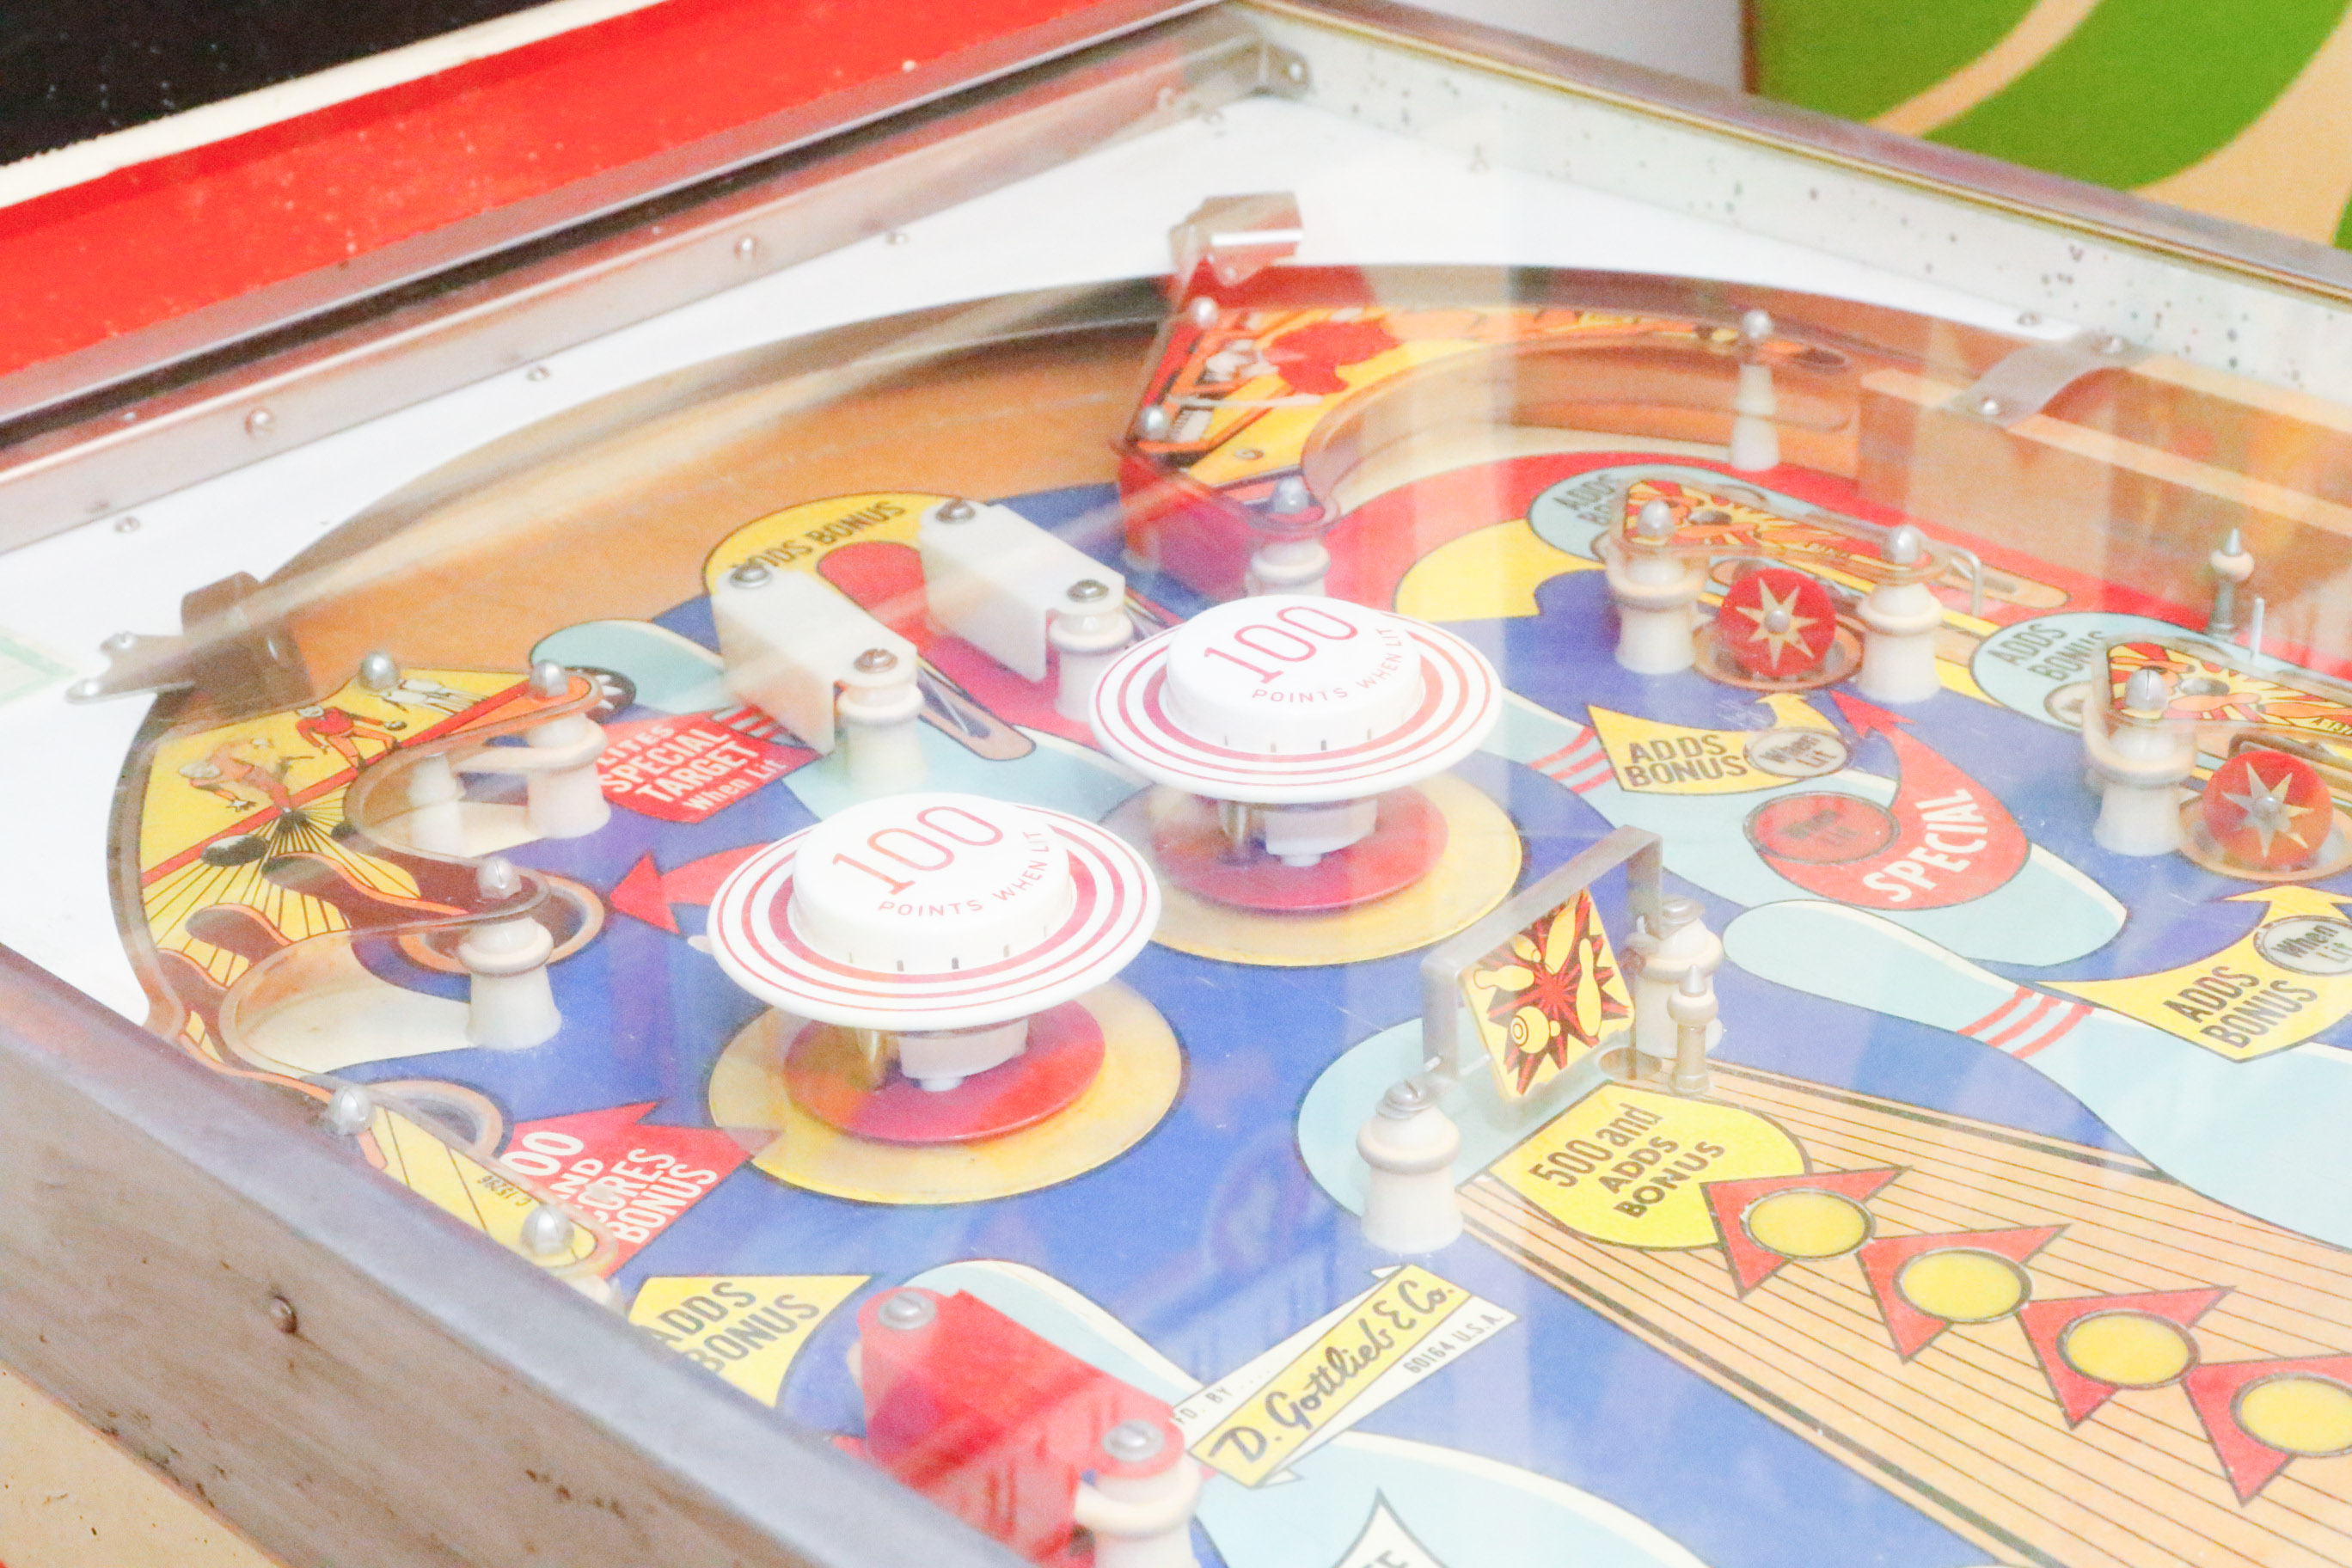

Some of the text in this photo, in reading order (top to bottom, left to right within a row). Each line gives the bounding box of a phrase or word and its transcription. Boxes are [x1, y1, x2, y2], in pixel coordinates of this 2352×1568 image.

[730, 500, 905, 570] DDS BONUS
[1204, 606, 1357, 684] 100
[1252, 628, 1403, 703] POINTS WHEN LIT
[1988, 623, 2067, 666] ADDS
[600, 728, 731, 793] SPECIAL
[634, 741, 759, 802] TARGET
[1625, 755, 1749, 787] BONUS
[1628, 734, 1728, 765] ADDS
[683, 759, 787, 811] When Lit
[832, 805, 1004, 895] 100
[879, 831, 1050, 917] POINTS WHEN LIT
[1862, 788, 1988, 903] SPECIAL
[2270, 925, 2339, 959] When
[2163, 965, 2260, 1023] ADDS
[2200, 979, 2318, 1049] BONUS
[1528, 1102, 1664, 1188] 500 and
[1598, 1136, 1680, 1194] ADDS
[549, 1159, 603, 1201] ND
[606, 1163, 718, 1244] BONUS
[1613, 1141, 1726, 1218] BONUS
[1265, 1318, 1396, 1430] Gottlieb
[1398, 1279, 1455, 1314] Co.
[1403, 1342, 1456, 1375] 60164
